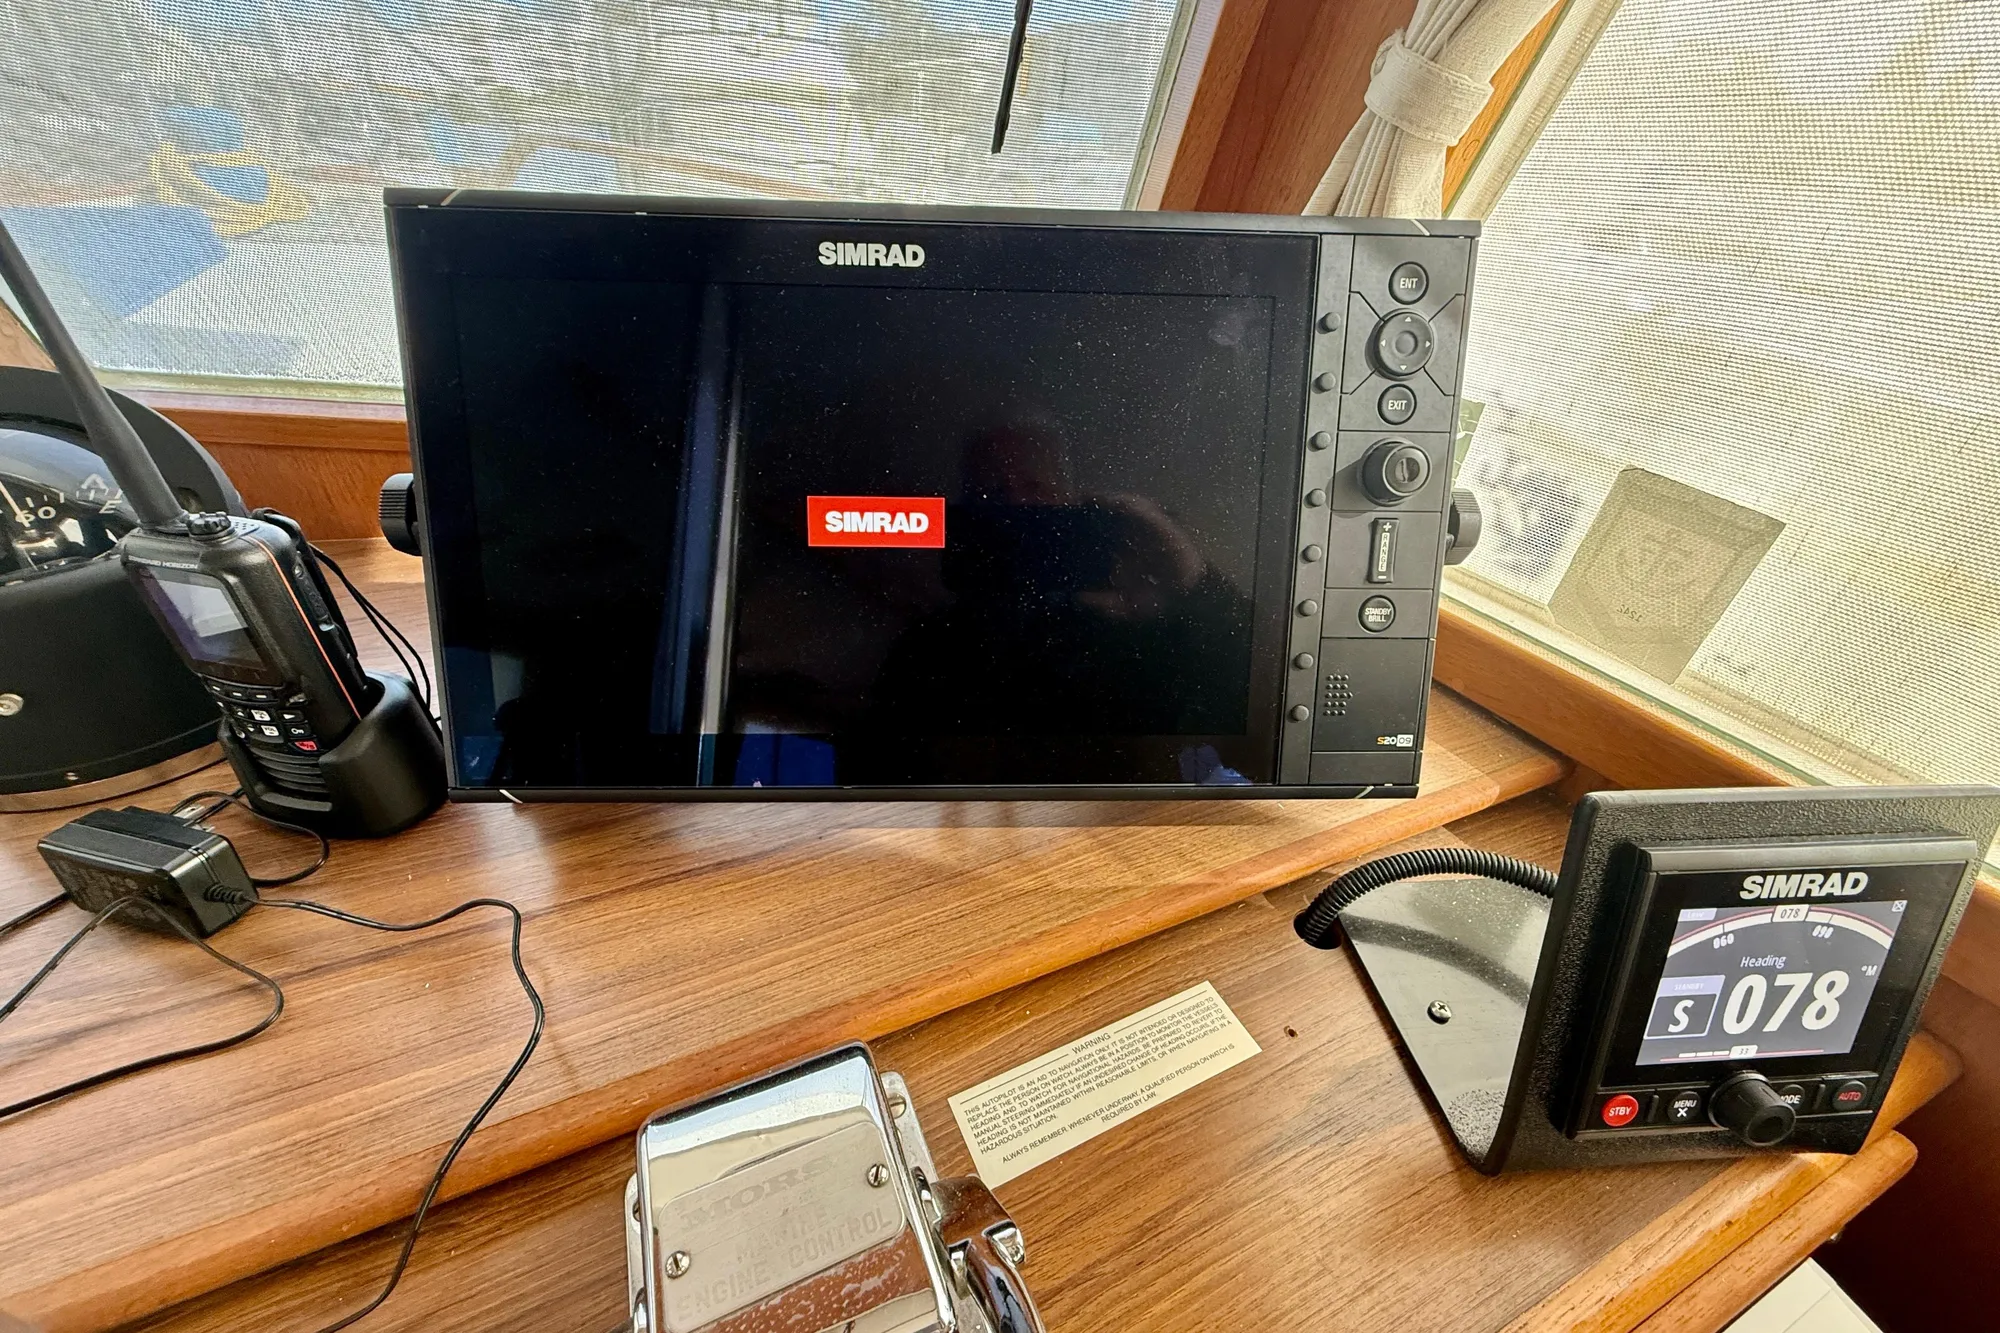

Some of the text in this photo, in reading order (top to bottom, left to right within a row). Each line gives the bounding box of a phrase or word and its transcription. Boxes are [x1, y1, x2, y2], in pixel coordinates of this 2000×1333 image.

[818, 241, 926, 268] SIMRAD
[1400, 278, 1418, 289] ENT
[1388, 400, 1407, 411] EXIT
[825, 511, 930, 534] SIMRAD
[1380, 533, 1389, 571] RANGE
[162, 561, 199, 570] HORIZON
[1364, 607, 1392, 616] STANDBY
[1368, 615, 1387, 623] BRILL
[1740, 872, 1869, 899] SIMRAD
[1780, 908, 1800, 919] 078
[1713, 933, 1735, 949] 060
[1812, 925, 1834, 939] 090
[1740, 955, 1786, 969] Heading
[1722, 970, 1850, 1035] 078
[1667, 999, 1695, 1033] S
[1072, 1032, 1111, 1054] WARNING
[964, 1105, 980, 1116] THIS
[982, 1088, 1016, 1108] AUTOPILOT
[1026, 1079, 1035, 1087] AN
[1037, 1073, 1047, 1083] AID
[1047, 1069, 1058, 1077] TO
[1058, 1052, 1094, 1072] NAVIGATION
[1125, 1031, 1138, 1041] NOT
[1138, 1018, 1167, 1034] INTENDED
[1167, 1013, 1177, 1021] OR
[1176, 1001, 1205, 1017] DESIGNED
[967, 1105, 998, 1123] REPLACE
[998, 1098, 1012, 1108] THE
[1012, 1086, 1040, 1102] PERSON
[1040, 1081, 1051, 1089] ON
[1075, 1058, 1098, 1073] ALWAYS
[1098, 1053, 1108, 1062] BE
[1119, 1035, 1148, 1051] POSITION
[1155, 1019, 1182, 1034] MONITOR
[1181, 1013, 1194, 1022] THE
[970, 1113, 1001, 1131] HEADING
[1003, 1105, 1016, 1116] AND
[1018, 1100, 1028, 1108] TO
[1028, 1089, 1052, 1103] WATCH
[1052, 1081, 1067, 1092] FOR
[1068, 1061, 1111, 1084] NAVIGATIONAL
[1141, 1041, 1151, 1050] BE
[1151, 1027, 1181, 1044] PREPARED
[1181, 1022, 1191, 1030] TO
[1191, 1012, 1213, 1025] REVERT
[973, 1122, 1002, 1138] MANUAL
[1002, 1105, 1035, 1125] STEERING
[1035, 1086, 1075, 1109] IMMEDIATELY
[1075, 1082, 1081, 1090] IF
[1083, 1078, 1092, 1086] AN
[1091, 1062, 1126, 1082] UNDESIRED
[1126, 1049, 1151, 1065] CHANGE
[1151, 1045, 1159, 1053] OF
[1159, 1033, 1186, 1049] HEADING
[1214, 1013, 1227, 1022] THE
[977, 1127, 1008, 1146] HEADING
[1009, 1123, 1017, 1131] IS
[1017, 1115, 1031, 1126] NOT
[1033, 1097, 1071, 1119] MAINTAINED
[1071, 1085, 1095, 1100] WITHIN
[1095, 1065, 1136, 1088] REASONABLE
[1157, 1050, 1168, 1058] OR
[1167, 1042, 1186, 1053] WHEN
[1186, 1026, 1219, 1044] NAVIGATING
[1838, 1090, 1862, 1101] AUTO
[1002, 1145, 1029, 1163] ALWAYS
[1068, 1108, 1105, 1129] WHENEVER
[1144, 1072, 1175, 1091] QUALIFIED
[1175, 1060, 1200, 1076] PERSON
[1199, 1056, 1209, 1064] ON
[1208, 1046, 1228, 1059] WATCH
[1101, 1102, 1134, 1122] REQUIRED
[1133, 1097, 1142, 1106] BY
[1674, 1099, 1697, 1109] MENU
[1780, 1094, 1801, 1105] ODE
[1608, 1106, 1633, 1117] STBY
[980, 1130, 1022, 1154] HAZARDOUS
[680, 1151, 840, 1232] MORS
[677, 1206, 893, 1322] ENGINE CONTROL
